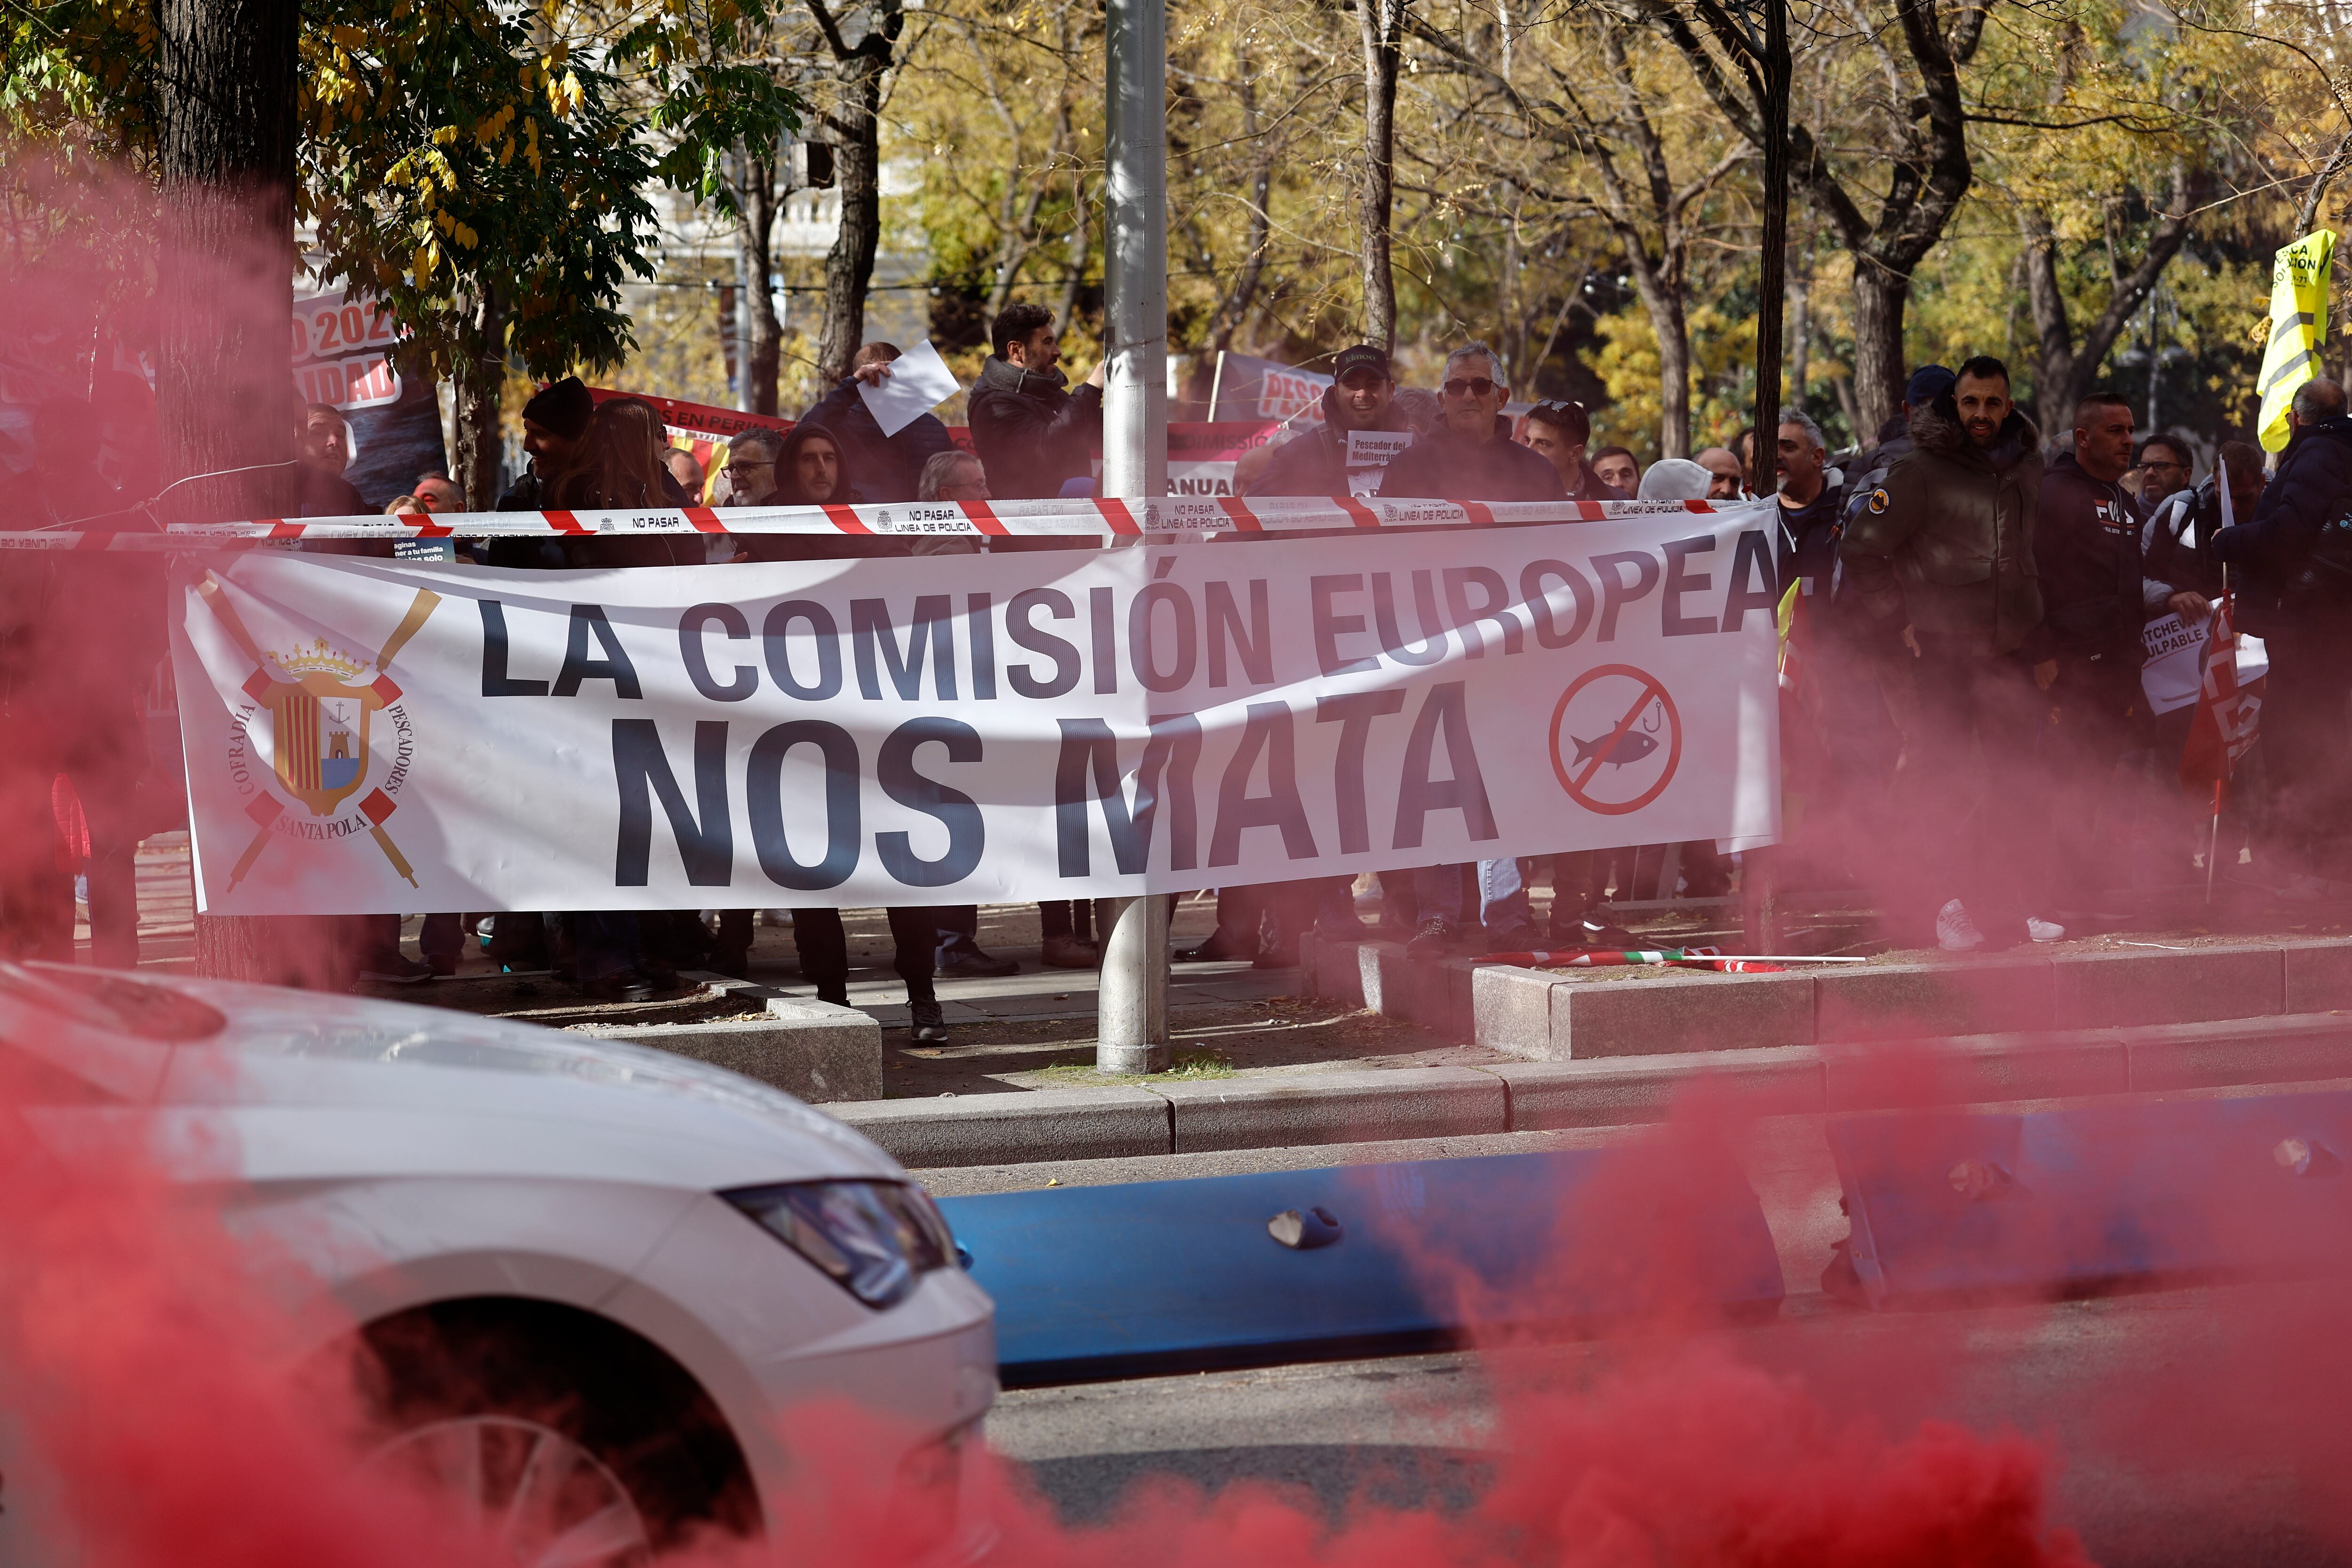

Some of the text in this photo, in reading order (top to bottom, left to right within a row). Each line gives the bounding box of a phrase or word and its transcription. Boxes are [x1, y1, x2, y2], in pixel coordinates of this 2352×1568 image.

[316, 301, 415, 350] 202
[292, 358, 396, 405] IDAD
[677, 412, 704, 427] EN
[1355, 439, 1391, 450] Pescador
[1393, 441, 1406, 450] del
[1167, 478, 1235, 495] ANUA
[909, 510, 954, 521] NO PASAR
[1175, 505, 1215, 515] NO PASAR
[1399, 511, 1421, 521] LINEA
[1423, 510, 1434, 520] DE
[1436, 509, 1463, 519] POLICIA
[1623, 506, 1643, 515] LINEA
[633, 517, 679, 528] NO PASAR
[938, 523, 972, 532] POLICIA
[1161, 518, 1184, 529] LINEA
[1186, 518, 1198, 528] DE
[1200, 517, 1230, 527] POLICIA
[19, 538, 47, 549] LINEA
[420, 546, 443, 554] familia
[477, 530, 1778, 702] LA COMISIÓN EUROPEA
[229, 704, 256, 796] COFRADIA
[384, 704, 413, 795] PESCADORES
[612, 681, 1499, 890] NOS MATA
[277, 812, 367, 840] SANTA POLA
